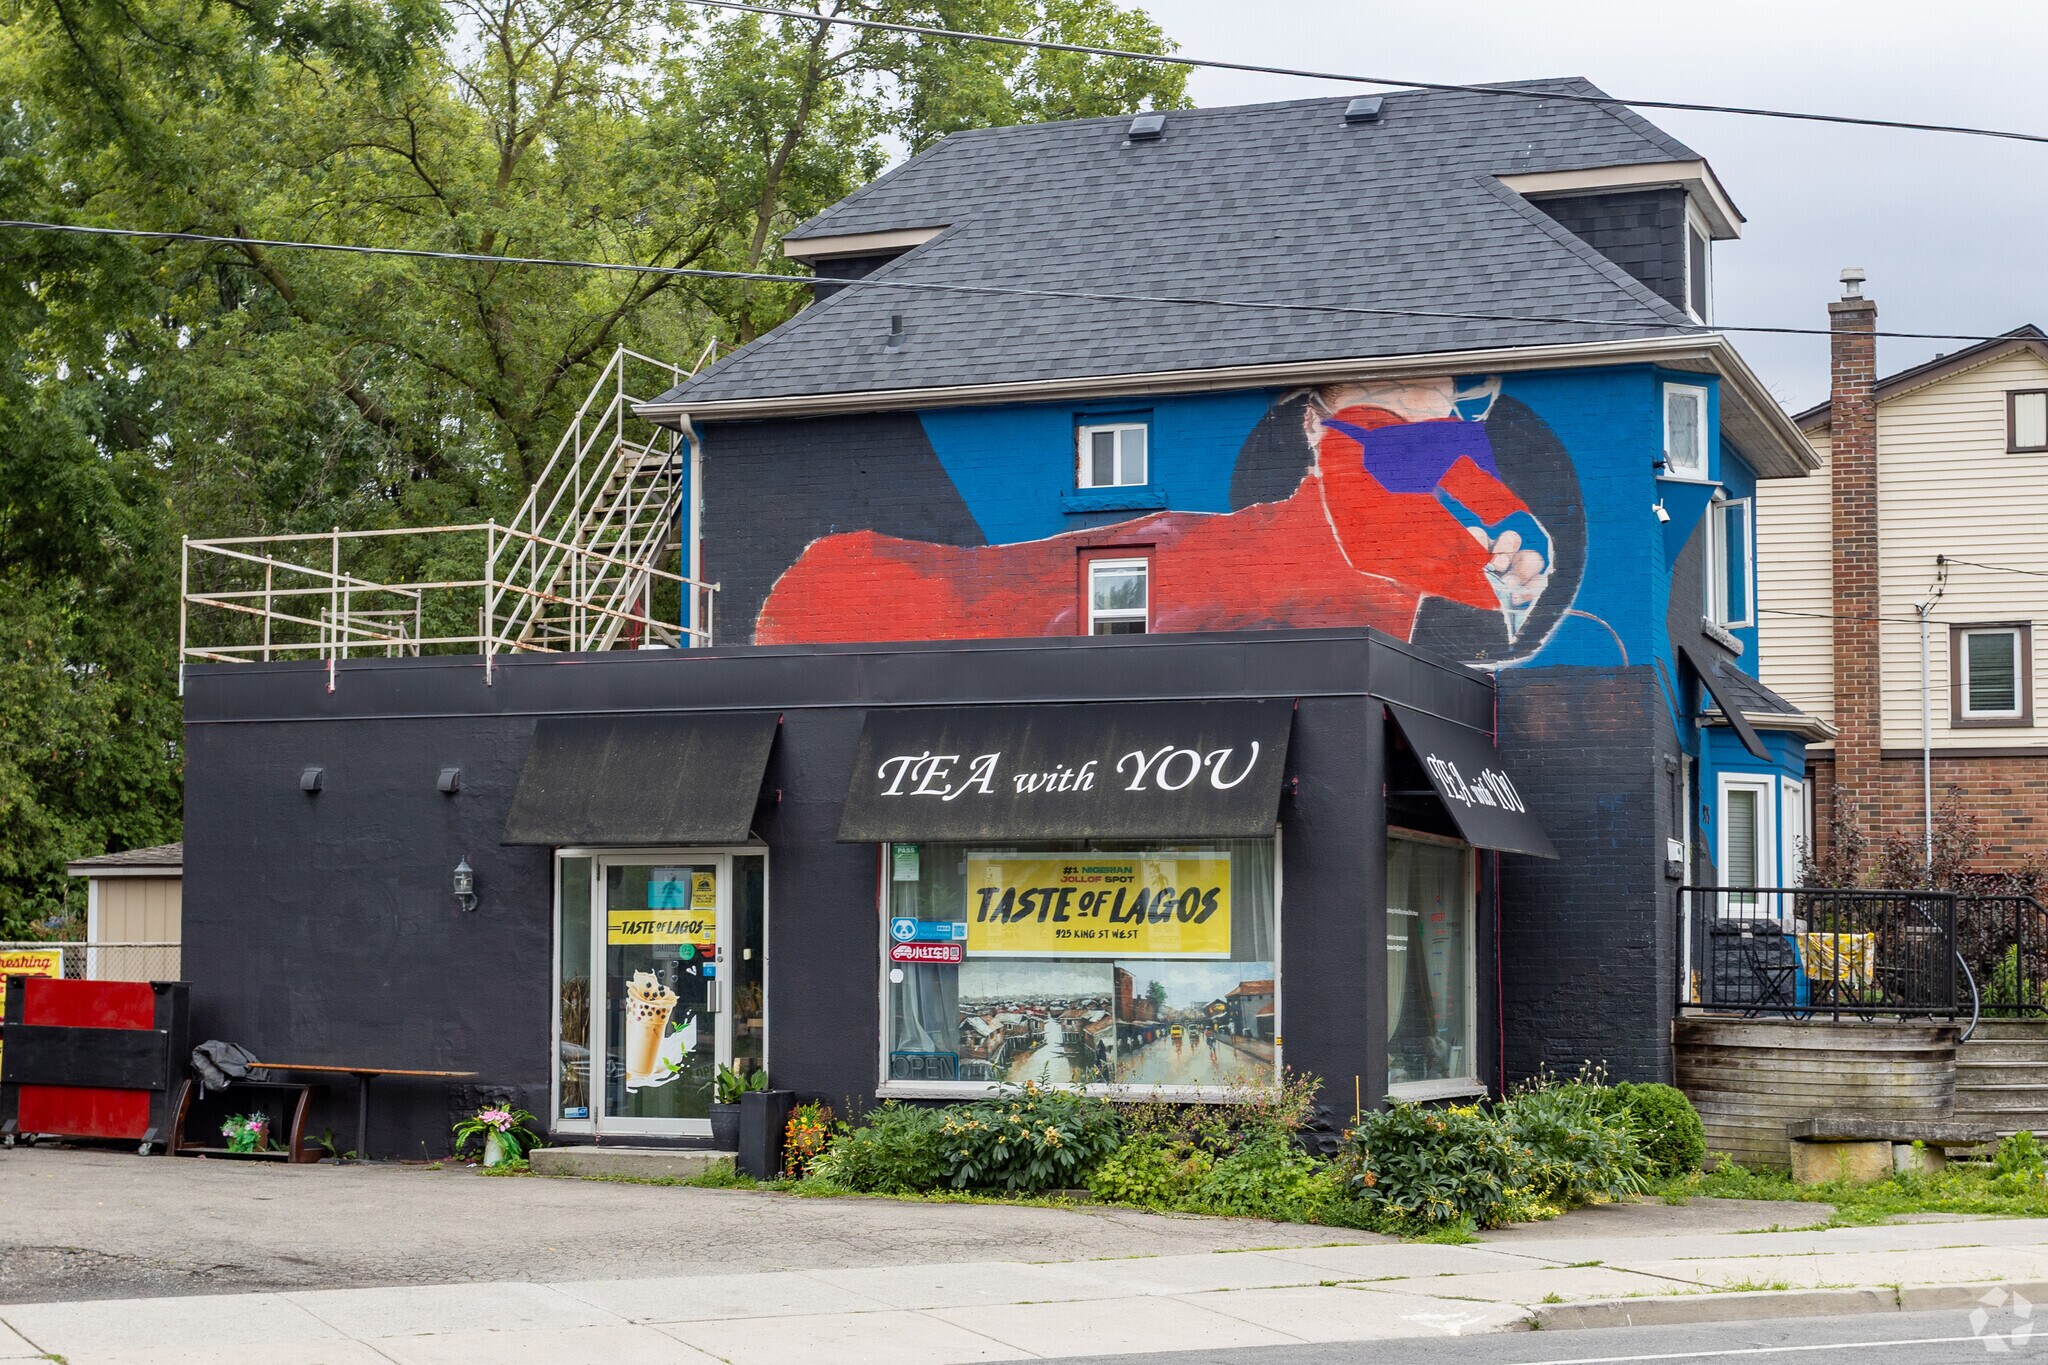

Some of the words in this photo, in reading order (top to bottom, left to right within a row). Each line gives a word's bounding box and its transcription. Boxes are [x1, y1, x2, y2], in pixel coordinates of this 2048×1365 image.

[877, 750, 1001, 801] TEA
[1013, 760, 1098, 794] with
[1116, 740, 1260, 791] YOU
[1426, 752, 1477, 808] TEA
[1481, 767, 1526, 814] YOU
[1062, 866, 1079, 875] #1
[1081, 866, 1133, 874] NIGERIAN
[1060, 875, 1102, 883] JOLLOF
[1104, 875, 1135, 883] SPOT
[976, 886, 1078, 924] TASTE
[1077, 890, 1112, 917] OF
[1109, 886, 1221, 925] LAGOS
[621, 920, 656, 935] TASTE
[656, 921, 668, 932] OF
[666, 920, 704, 935] LAGOS
[1055, 929, 1072, 939] 925
[1074, 929, 1095, 939] KING
[1098, 929, 1110, 939] ST
[1112, 928, 1139, 939] WEST
[912, 946, 943, 959] 小红车
[0, 955, 51, 970] reshing
[893, 1056, 955, 1079] OPEN
